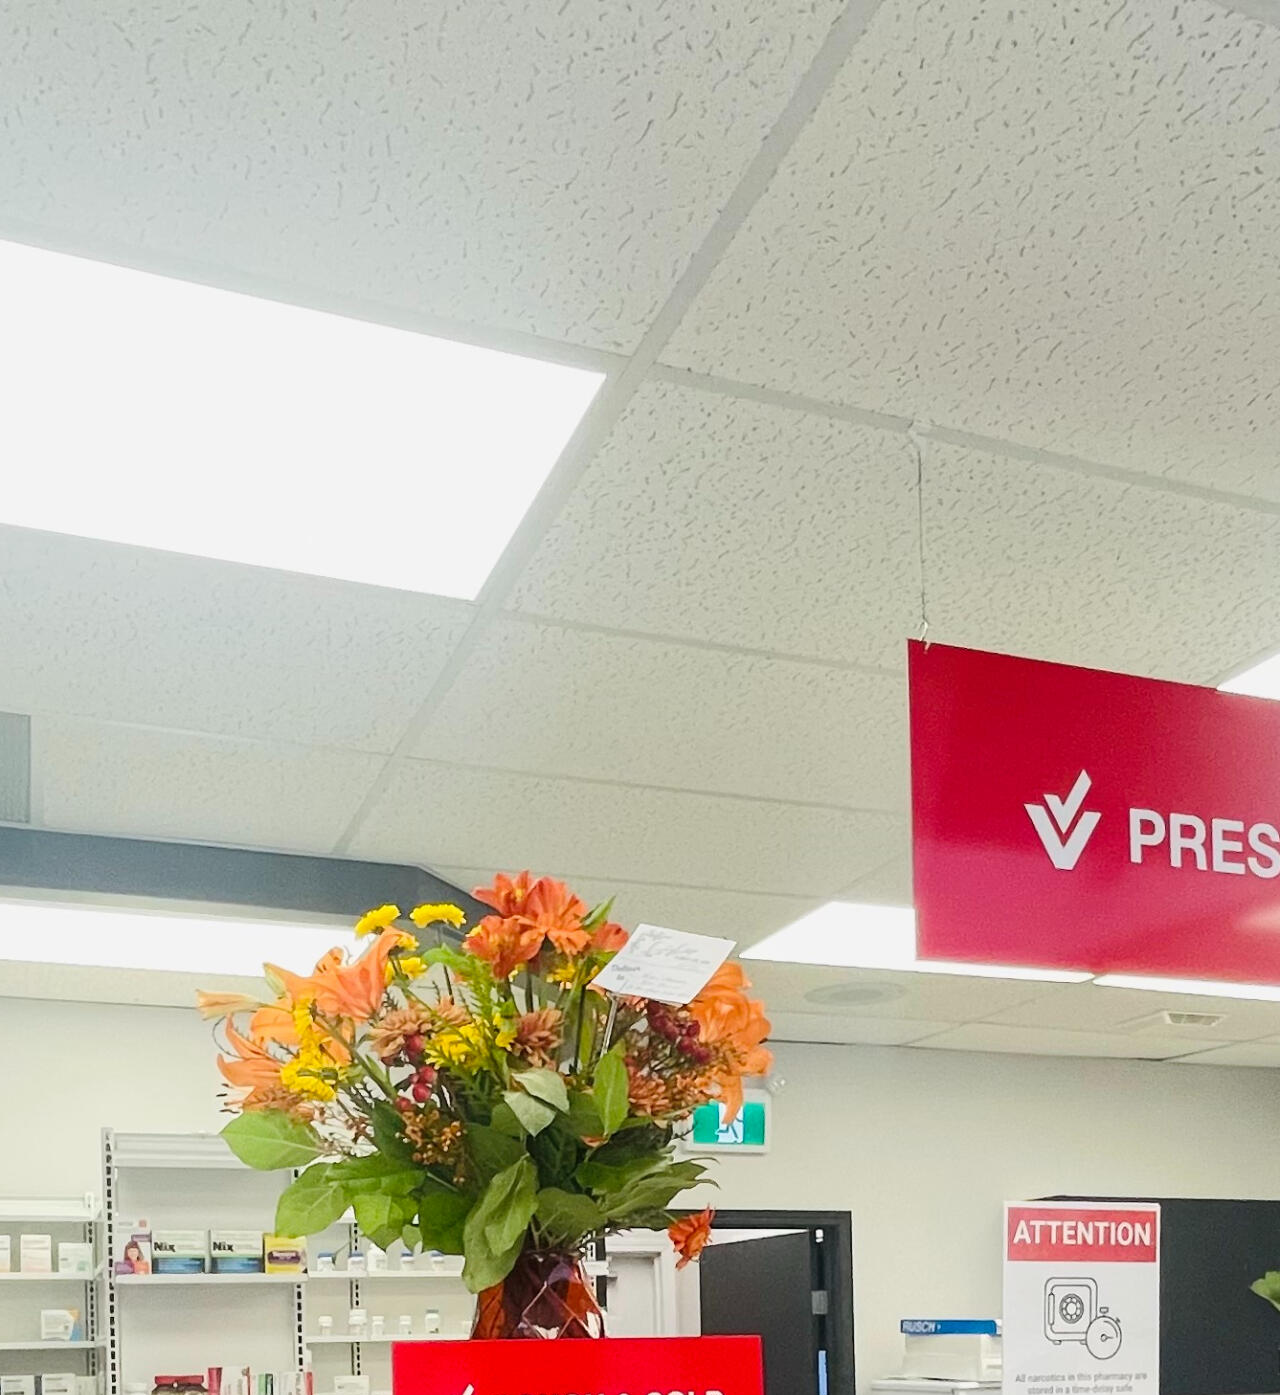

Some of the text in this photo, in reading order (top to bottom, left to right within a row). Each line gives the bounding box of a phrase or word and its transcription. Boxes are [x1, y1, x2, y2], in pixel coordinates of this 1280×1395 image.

[1013, 1221, 1151, 1246] ATTENTION
[154, 1241, 176, 1252] Nix
[213, 1241, 234, 1252] Nix
